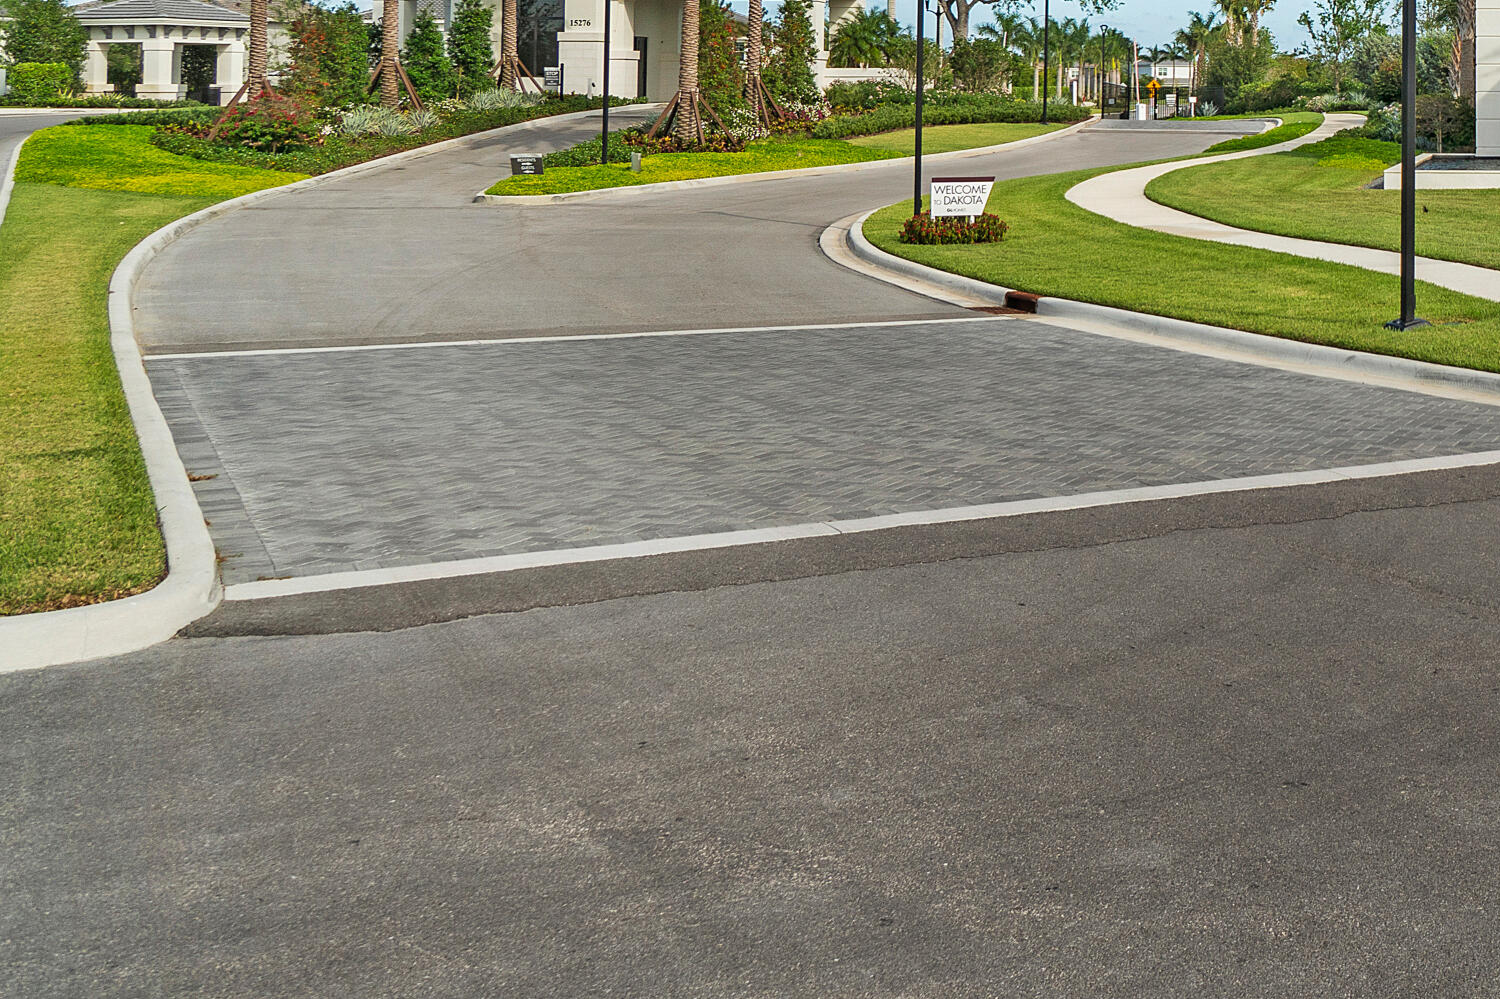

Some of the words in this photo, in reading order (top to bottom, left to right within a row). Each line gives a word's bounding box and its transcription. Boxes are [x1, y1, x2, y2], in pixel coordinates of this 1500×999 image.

[570, 19, 591, 27] 15276
[934, 185, 987, 194] WELCOME
[943, 196, 983, 205] DAKOTA
